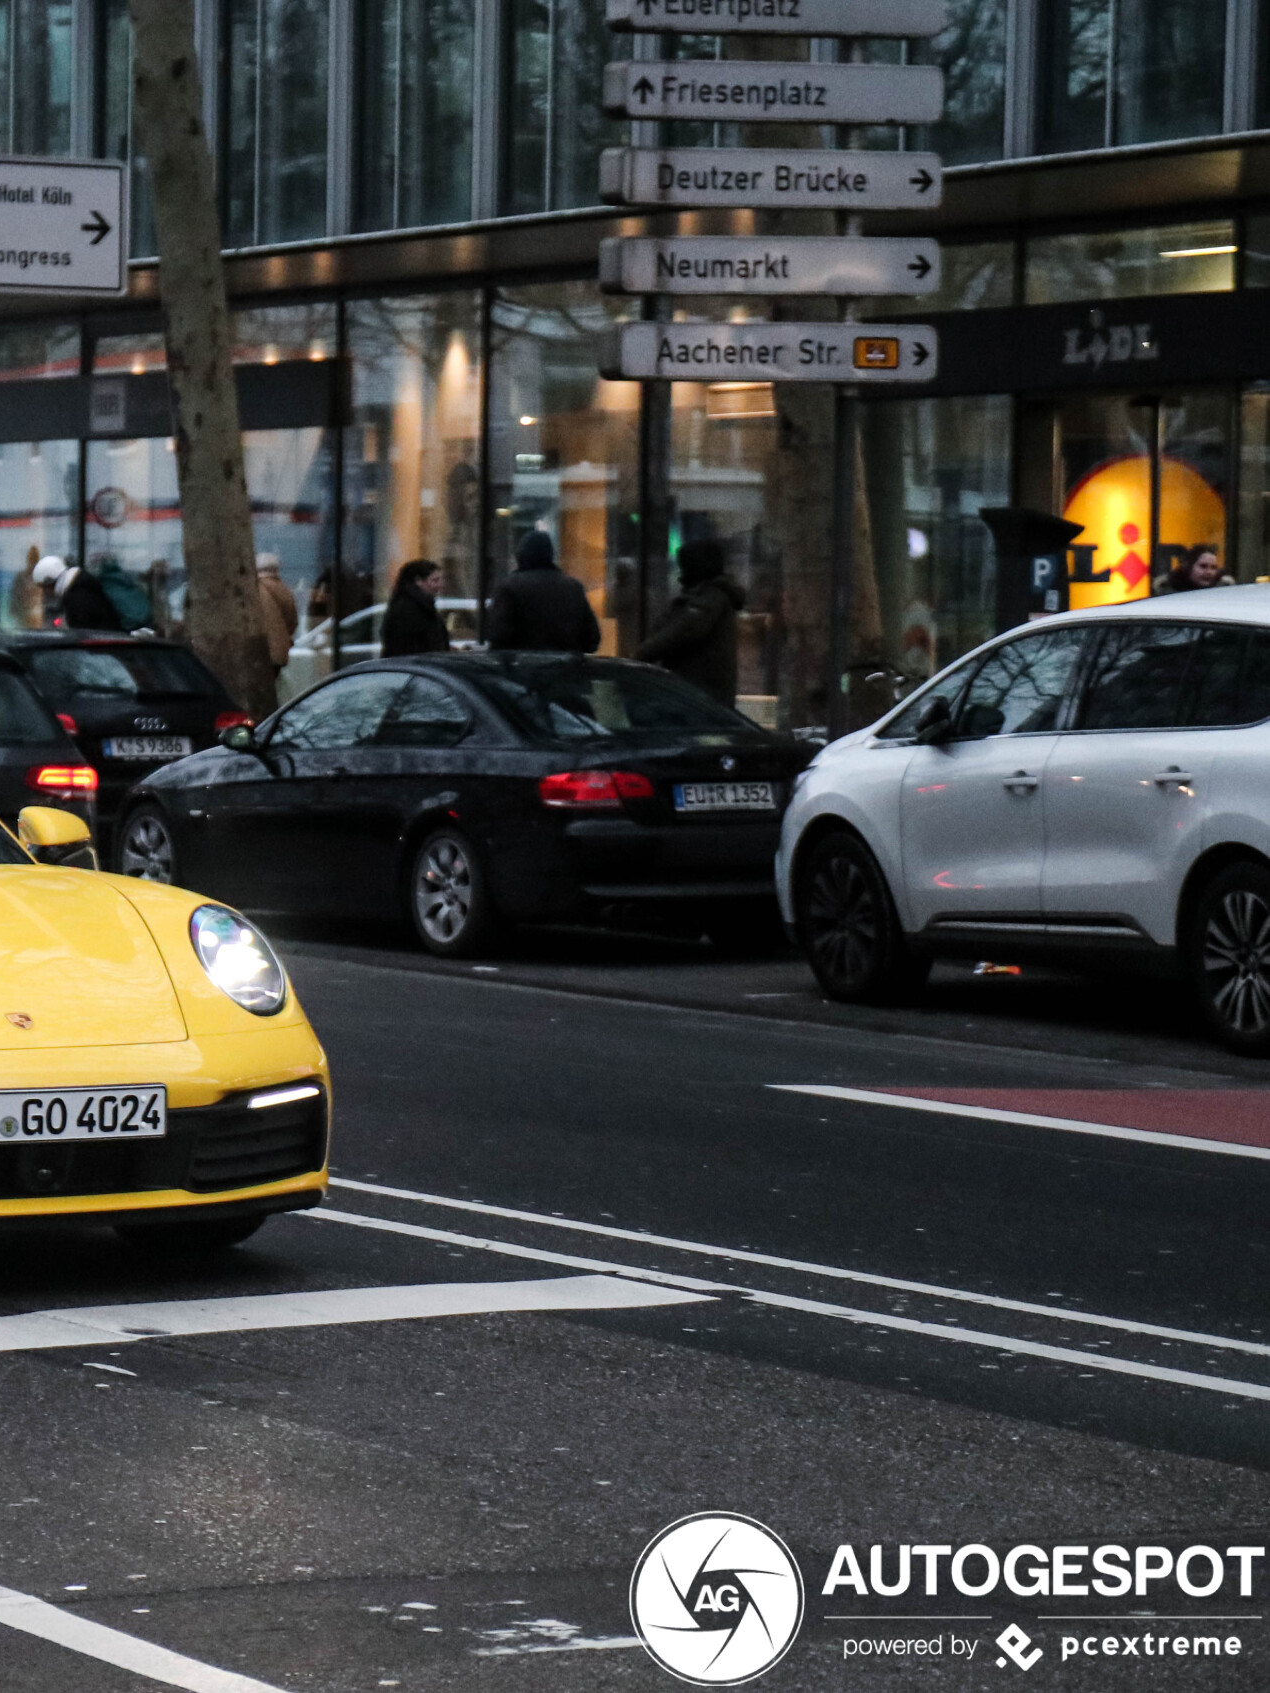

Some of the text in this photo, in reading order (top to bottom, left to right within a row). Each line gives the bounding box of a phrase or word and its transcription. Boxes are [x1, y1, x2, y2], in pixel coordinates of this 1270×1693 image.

[662, 76, 827, 111] Friesenplatz
[658, 164, 867, 192] Deutzer Brücke
[0, 184, 34, 203] Hotel
[42, 187, 73, 205] Köln
[656, 253, 790, 279] Neumarkt
[657, 339, 783, 364] Aachener
[798, 340, 841, 364] Str.
[1034, 558, 1051, 587] P
[732, 784, 770, 802] 1352
[21, 1097, 67, 1135] GO
[76, 1093, 160, 1132] 4024
